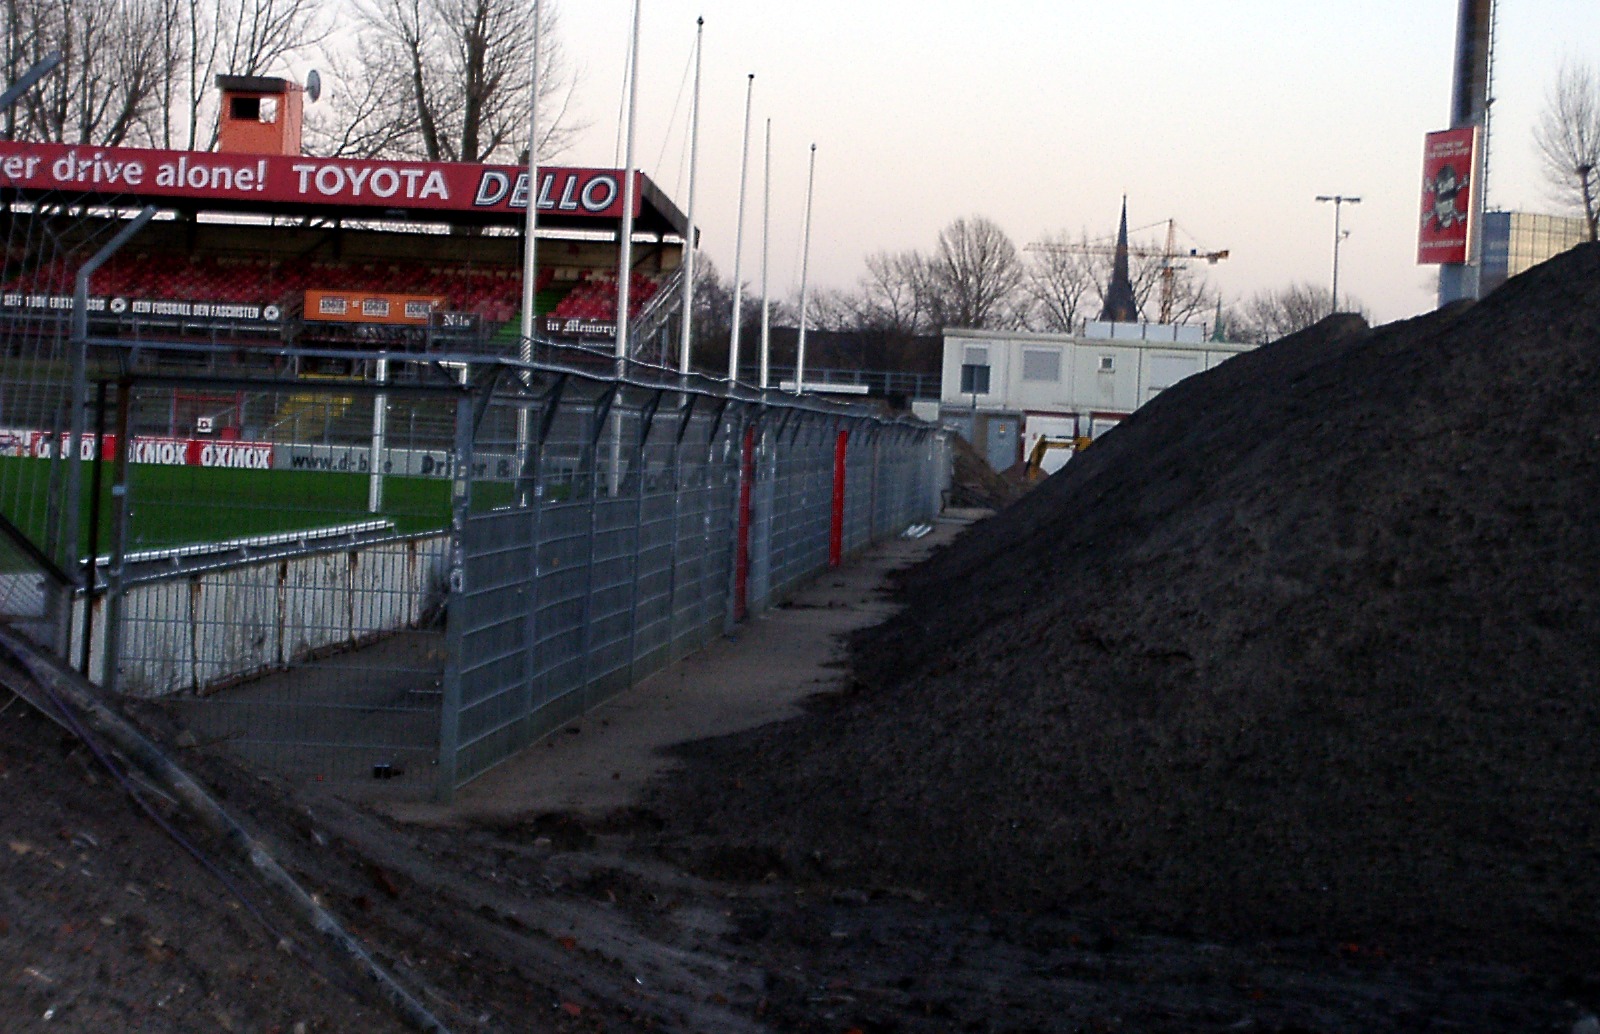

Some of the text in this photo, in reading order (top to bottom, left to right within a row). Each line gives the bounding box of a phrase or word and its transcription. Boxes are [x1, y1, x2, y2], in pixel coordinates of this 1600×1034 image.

[0, 150, 267, 191] er drive alone!
[292, 163, 449, 200] TOYOTA
[473, 169, 619, 213] DELLO
[546, 319, 617, 337] in Memory
